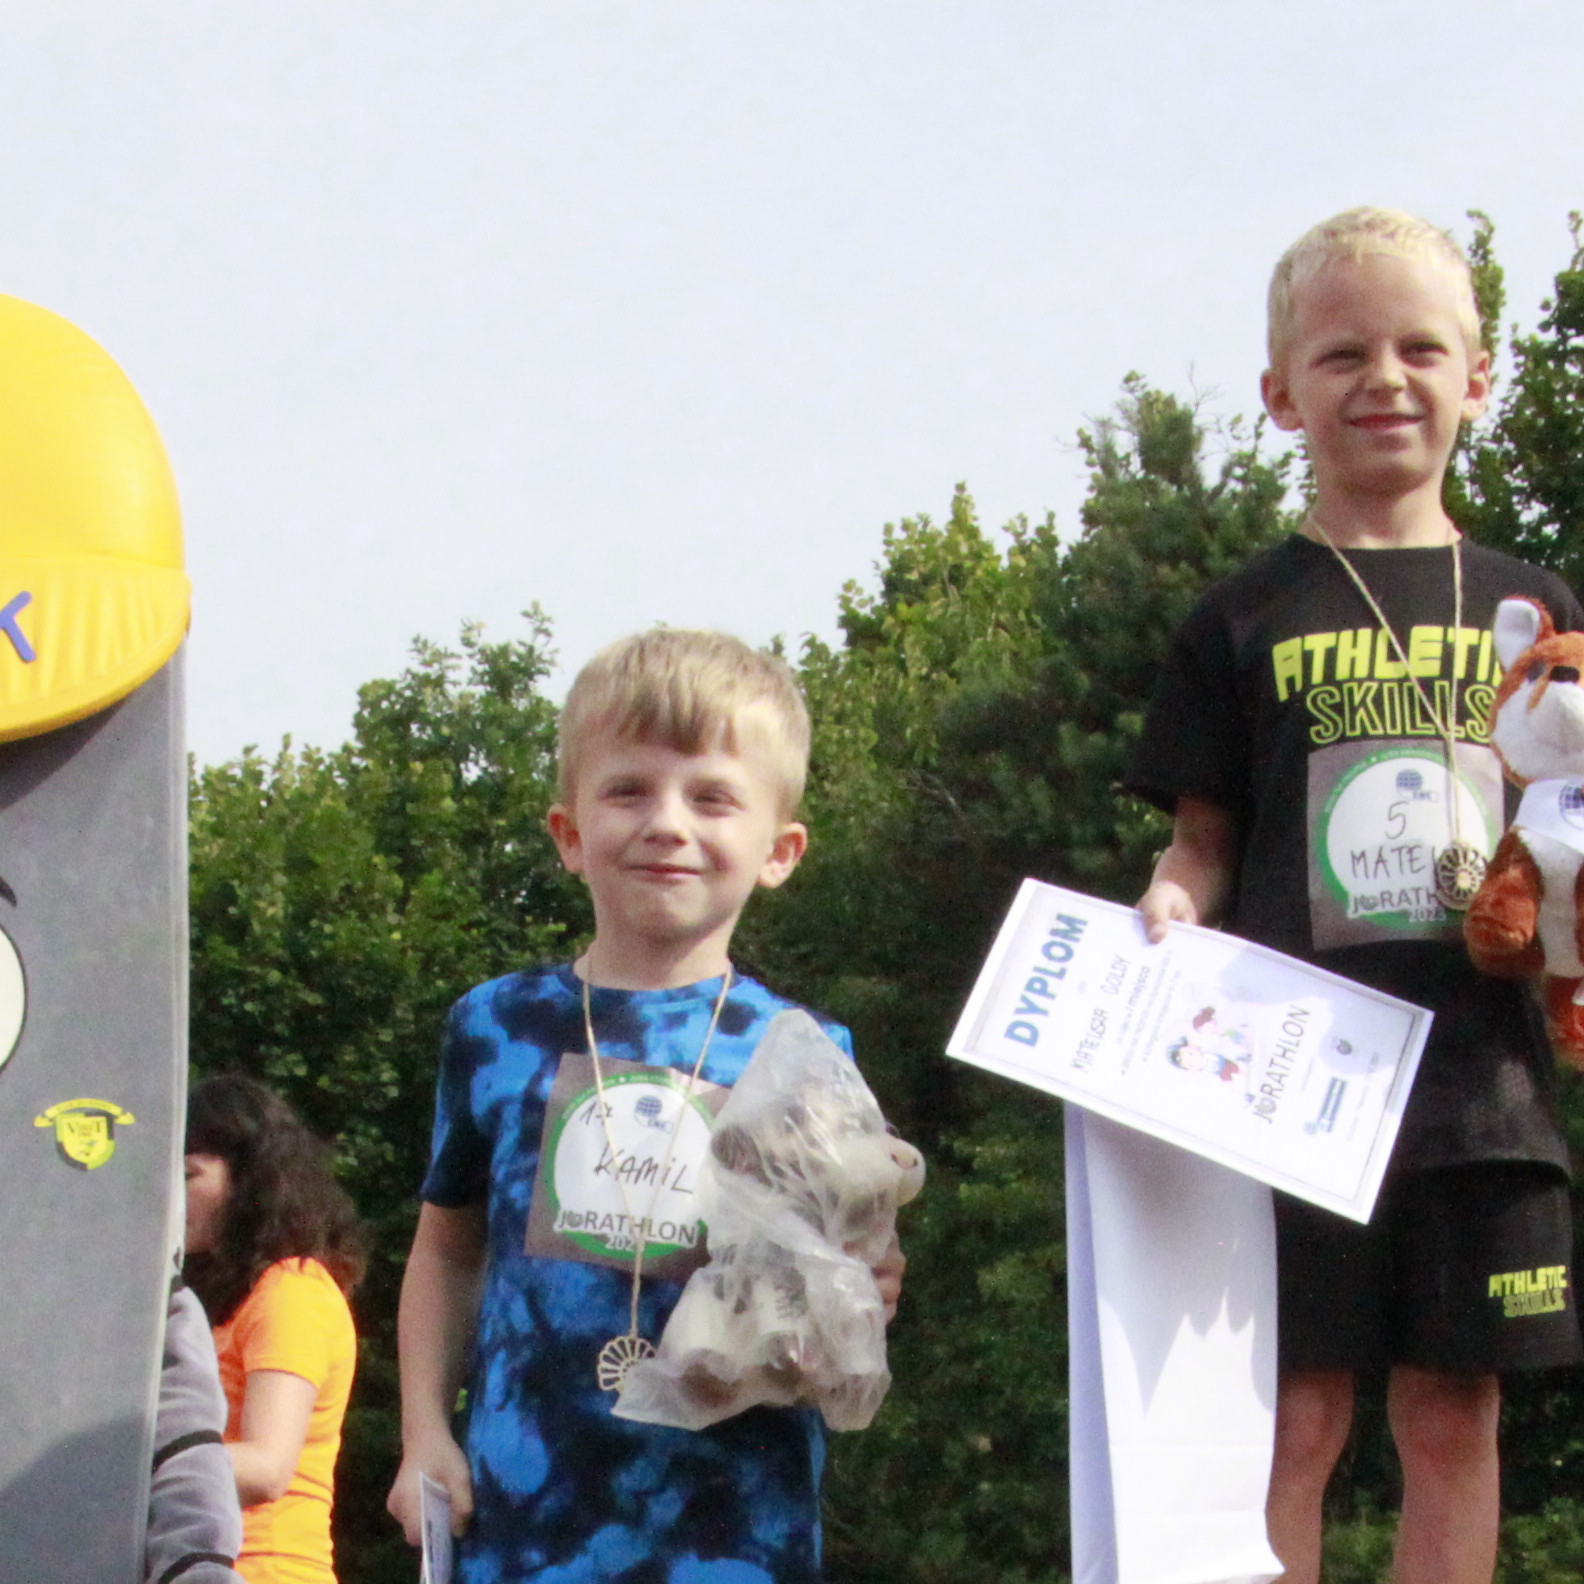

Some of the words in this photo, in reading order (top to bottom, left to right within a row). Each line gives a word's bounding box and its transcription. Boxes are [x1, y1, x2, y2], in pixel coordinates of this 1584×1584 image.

[1273, 626, 1503, 702] ATHLETI
[1307, 681, 1496, 744] SKILLS
[1385, 800, 1409, 840] 5
[1004, 912, 1089, 1048] DYPLOM
[1488, 1265, 1568, 1298] ATHLETIC
